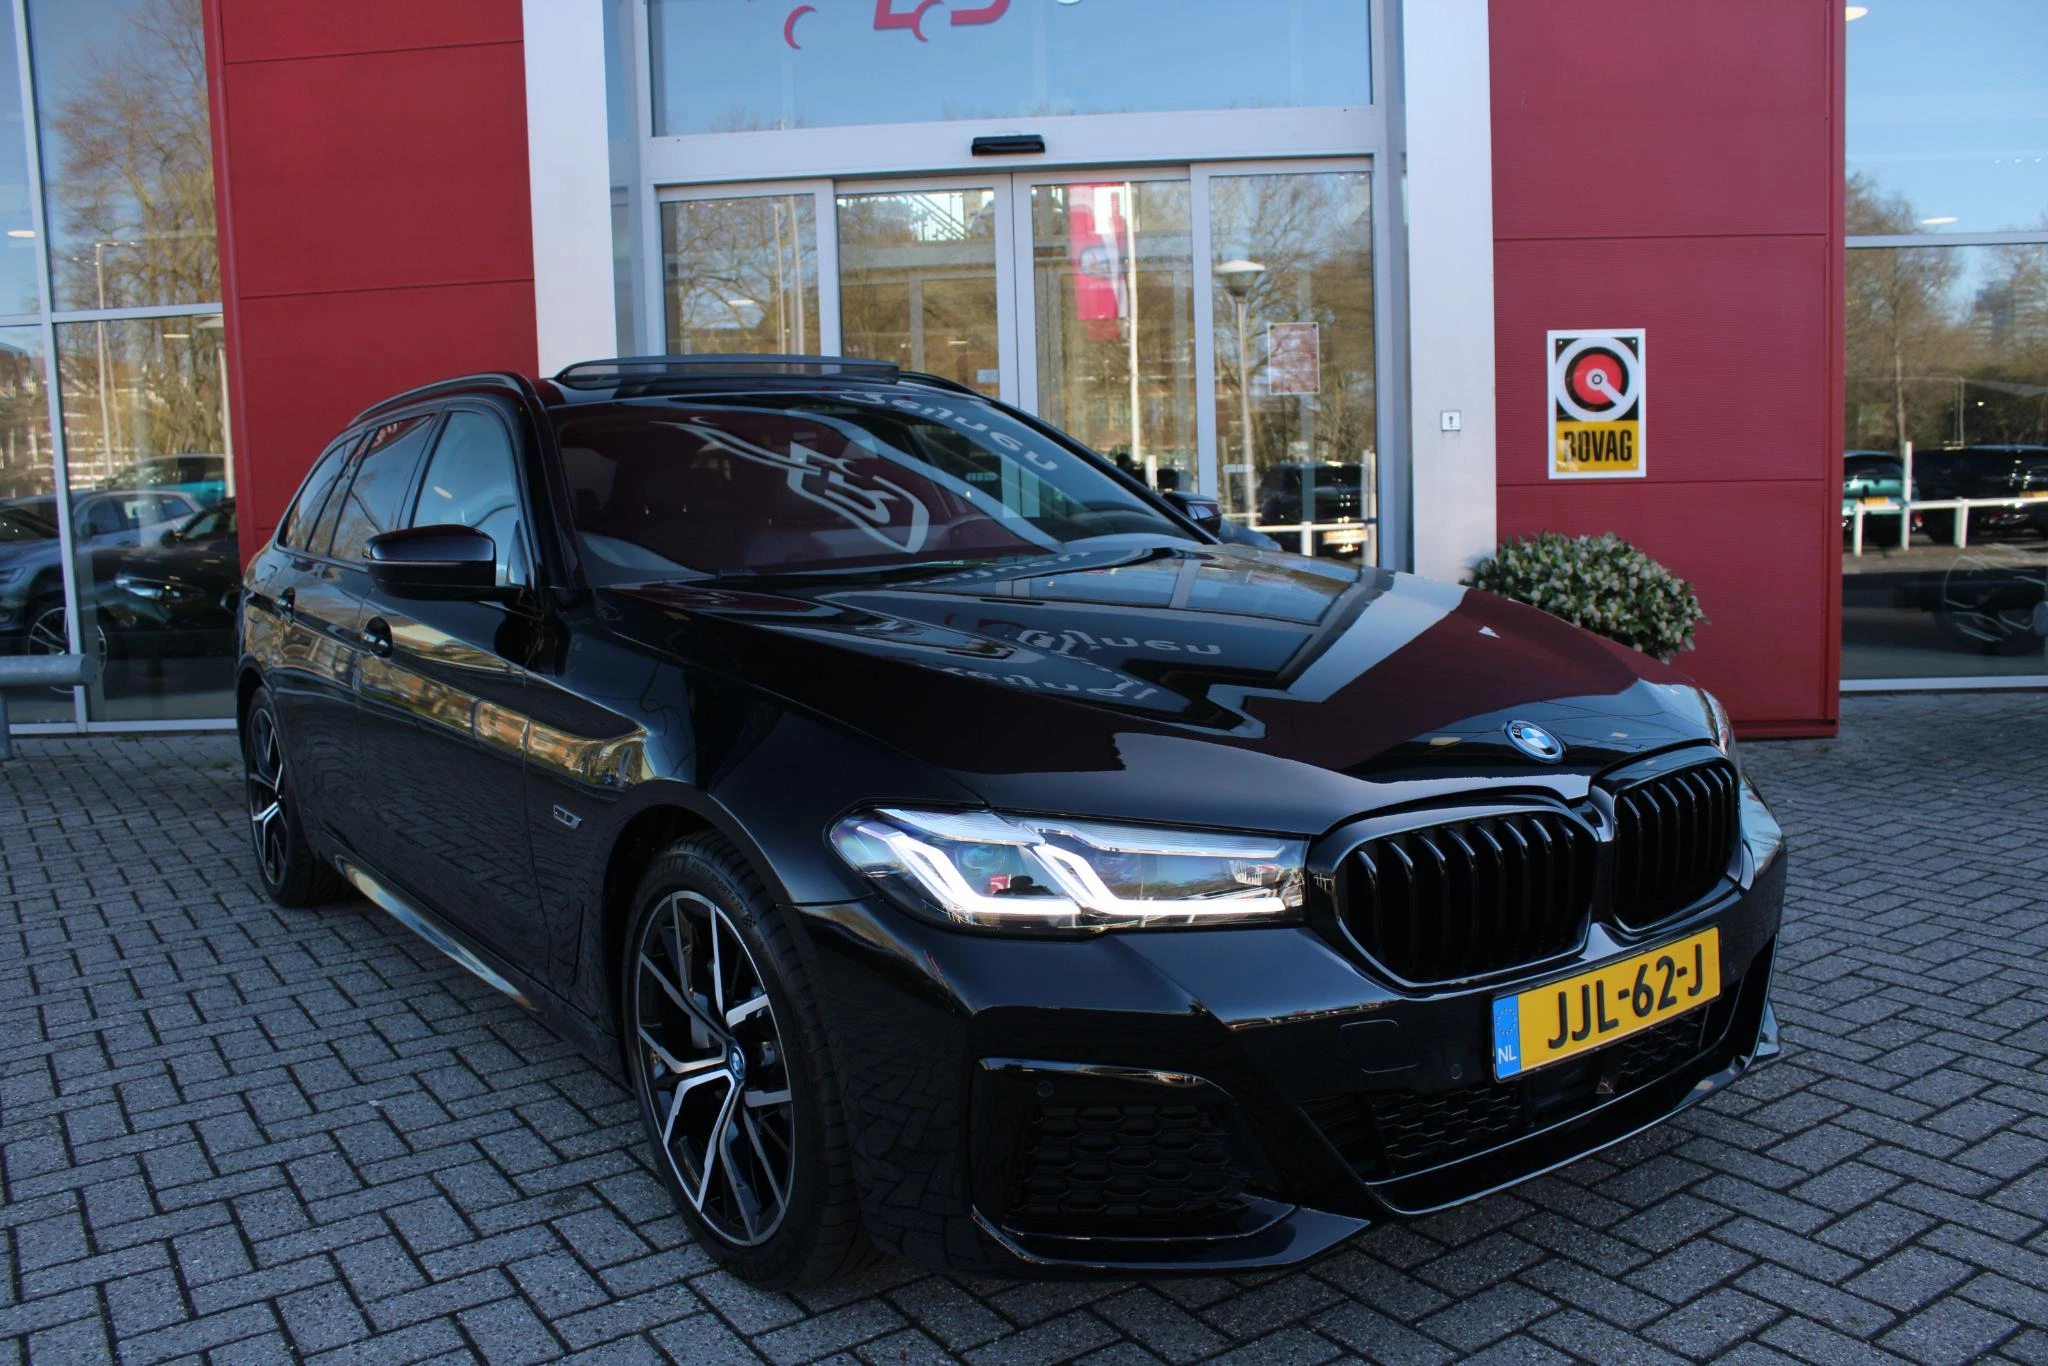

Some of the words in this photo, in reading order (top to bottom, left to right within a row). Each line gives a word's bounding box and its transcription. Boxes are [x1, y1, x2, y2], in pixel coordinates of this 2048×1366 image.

[1563, 429, 1632, 462] BOVAG
[1548, 944, 1703, 1049] JJL-62-J
[1498, 1044, 1517, 1064] NL
